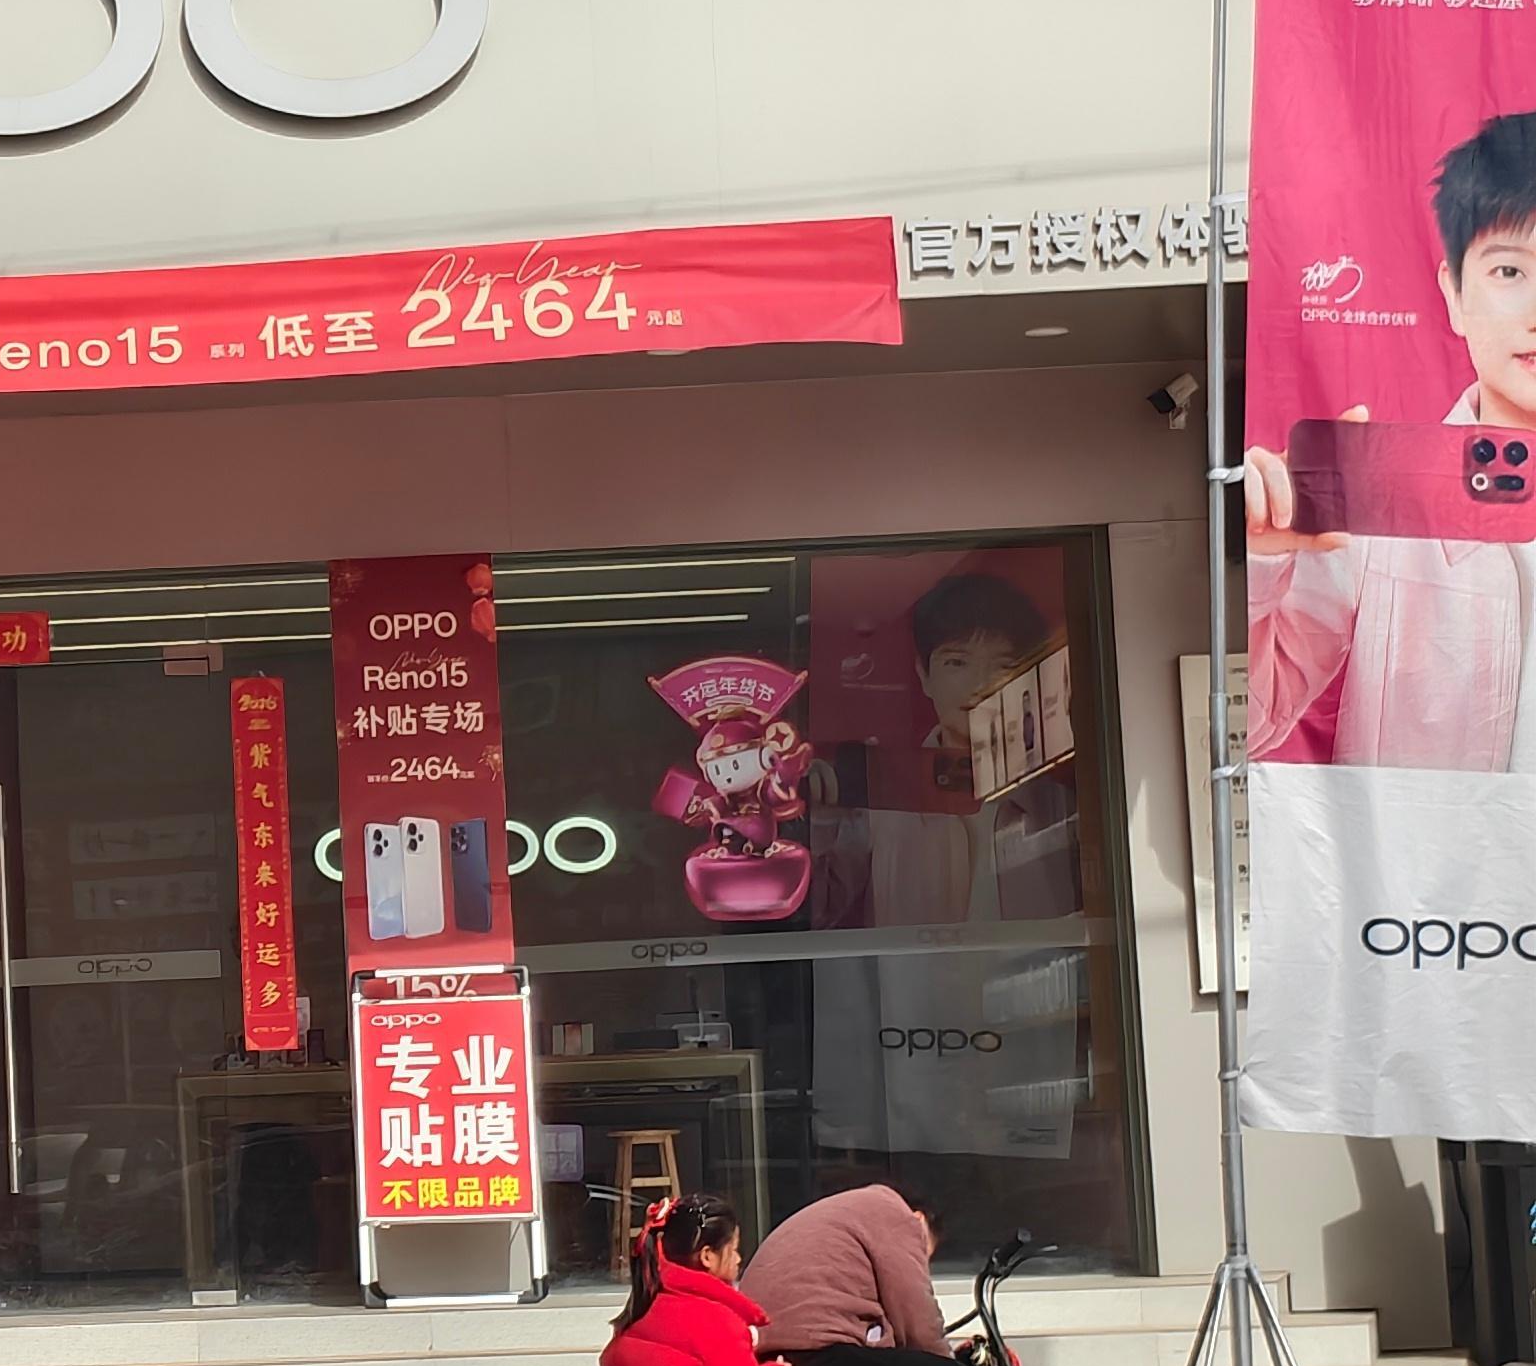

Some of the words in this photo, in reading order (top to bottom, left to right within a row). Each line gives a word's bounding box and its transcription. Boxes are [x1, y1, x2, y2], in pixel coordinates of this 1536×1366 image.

[210, 343, 245, 359] 系列
[258, 311, 378, 360] 低至
[404, 275, 638, 348] 2464
[369, 611, 458, 641] OPPO
[363, 661, 469, 692] Reno15
[353, 700, 484, 738] 补贴专场
[390, 755, 461, 782] 2464
[249, 742, 283, 1008] 紫气东来好运多
[631, 941, 708, 963] oppo
[878, 1027, 1003, 1057] oppo
[375, 1034, 517, 1100] 专业
[379, 1101, 520, 1169] 贴膜
[381, 1176, 522, 1211] 不限品牌
